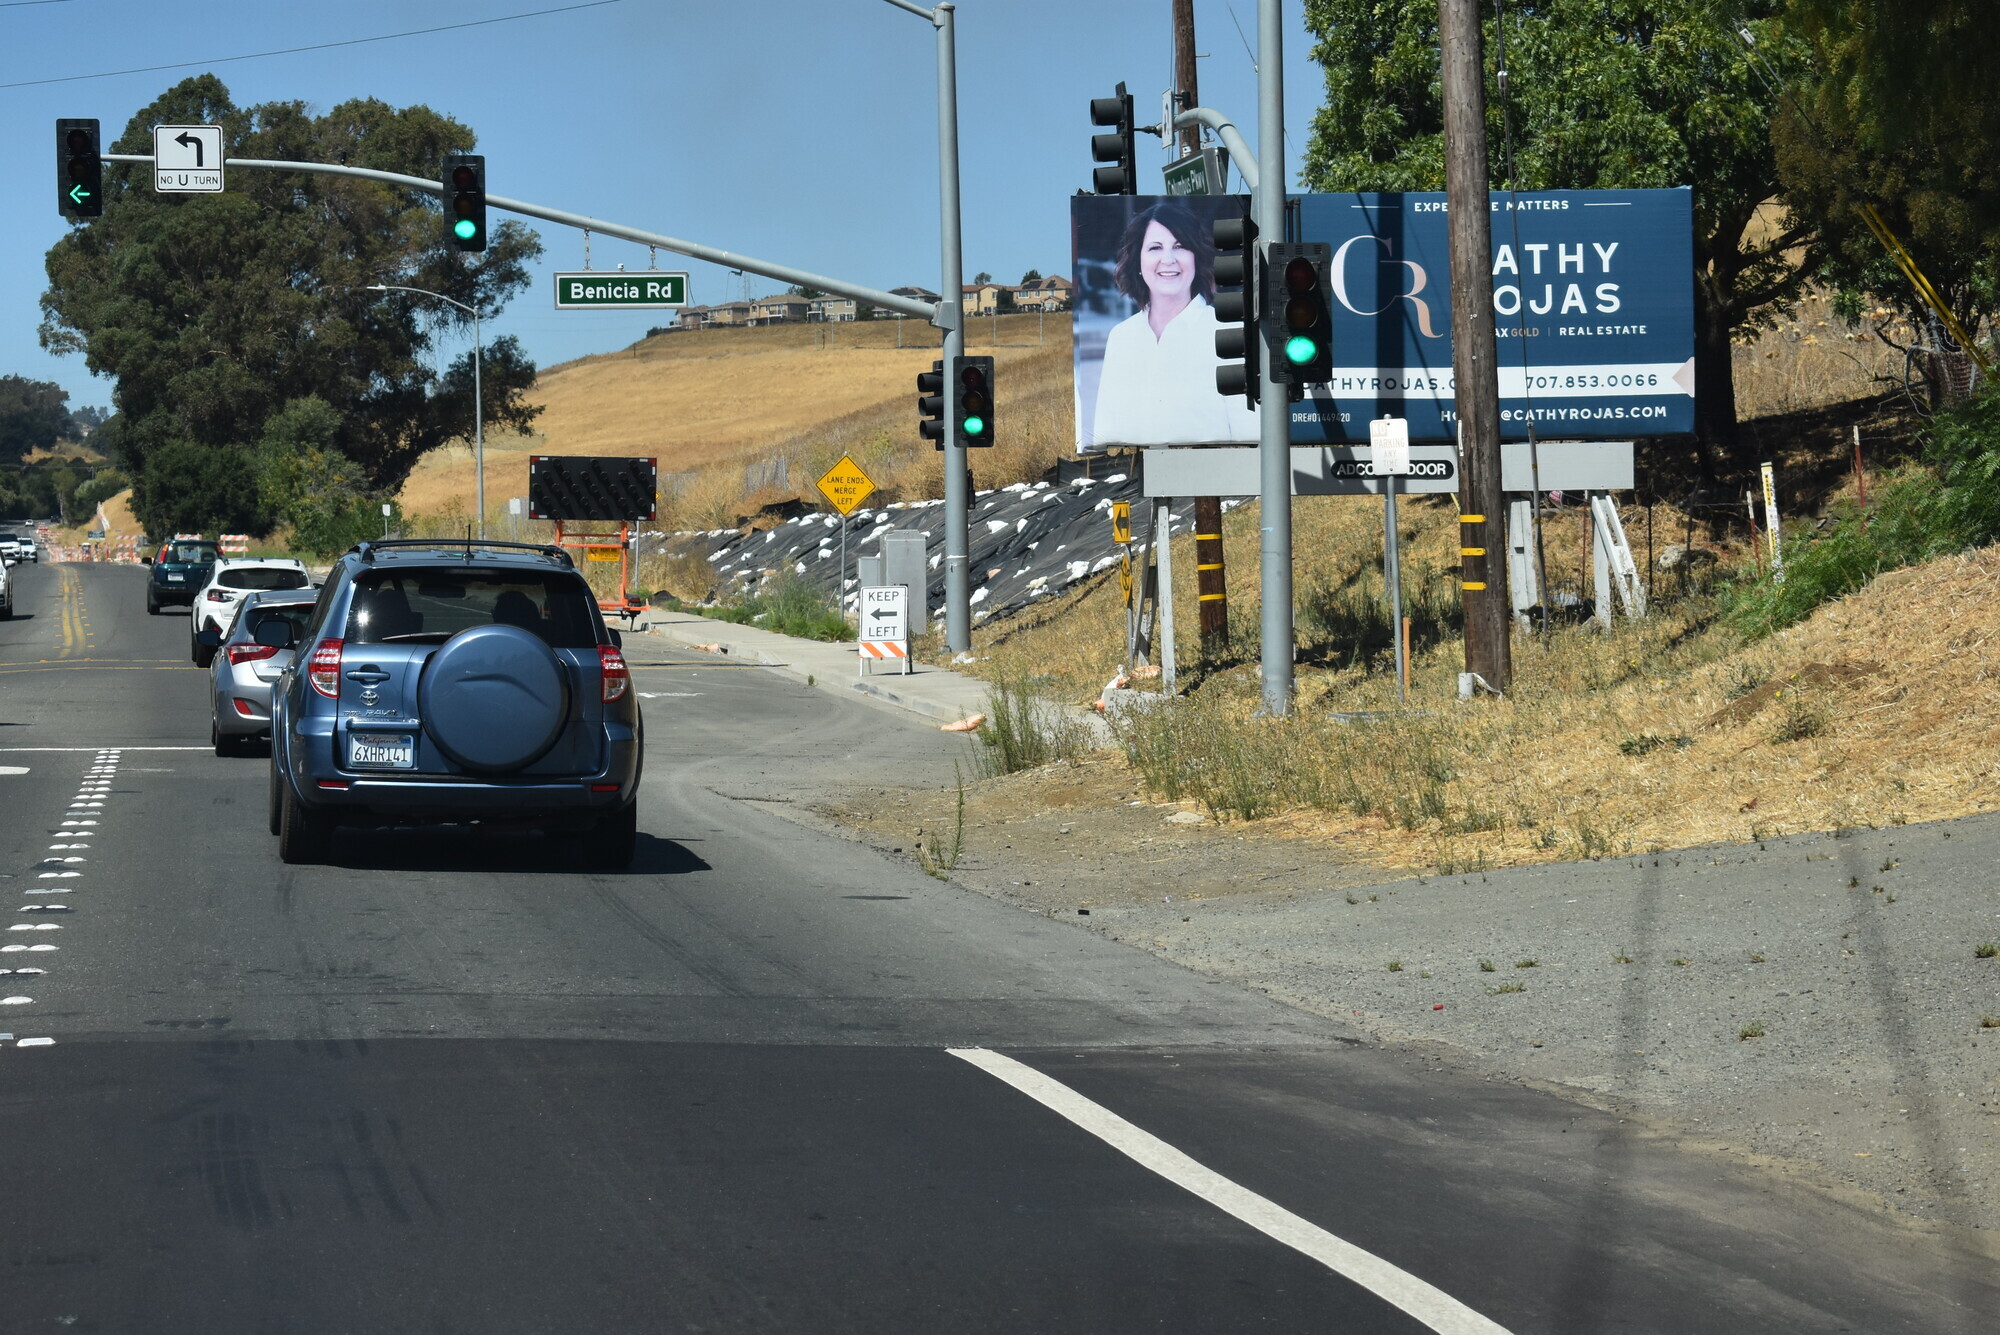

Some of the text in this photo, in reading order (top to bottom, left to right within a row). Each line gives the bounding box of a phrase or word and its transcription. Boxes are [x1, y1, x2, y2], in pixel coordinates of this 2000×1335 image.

[160, 174, 218, 186] NO U TURN
[1414, 200, 1569, 212] EXPEE MATTERS
[1492, 242, 1619, 275] ATHY
[570, 282, 672, 299] Benicia Rd
[1493, 283, 1621, 315] OJAS
[1511, 327, 1540, 337] GOLD
[1559, 326, 1593, 336] REAL
[1597, 325, 1647, 335] ESTATE
[1526, 374, 1658, 389] 707.853.0066
[1372, 422, 1387, 435] NO
[1374, 437, 1405, 449] PARKING
[1384, 449, 1397, 458] ANY
[1384, 459, 1399, 468] TIME
[826, 476, 865, 484] LANE ENDS
[834, 487, 857, 495] MERGE
[837, 497, 853, 505] LEFT
[868, 591, 899, 602] KEEP
[868, 626, 898, 637] LEFT
[363, 735, 401, 746] California
[354, 746, 408, 762] 6XHR141
